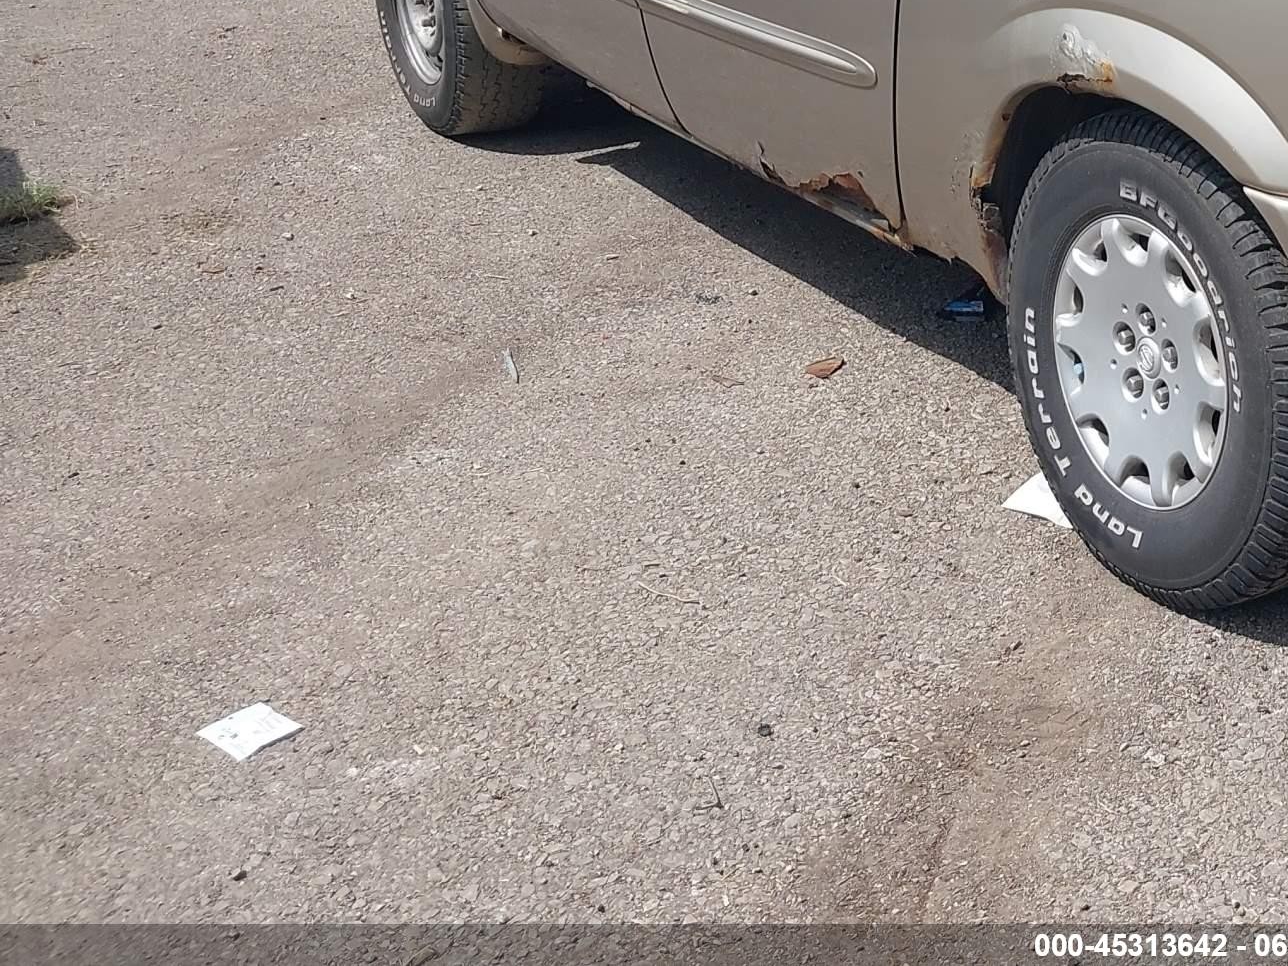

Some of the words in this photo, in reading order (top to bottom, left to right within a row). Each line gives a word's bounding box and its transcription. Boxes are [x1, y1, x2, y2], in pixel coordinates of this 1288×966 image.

[1118, 179, 1243, 414] BFGoodrich
[1023, 307, 1073, 479] Terrain
[1073, 482, 1144, 550] Land
